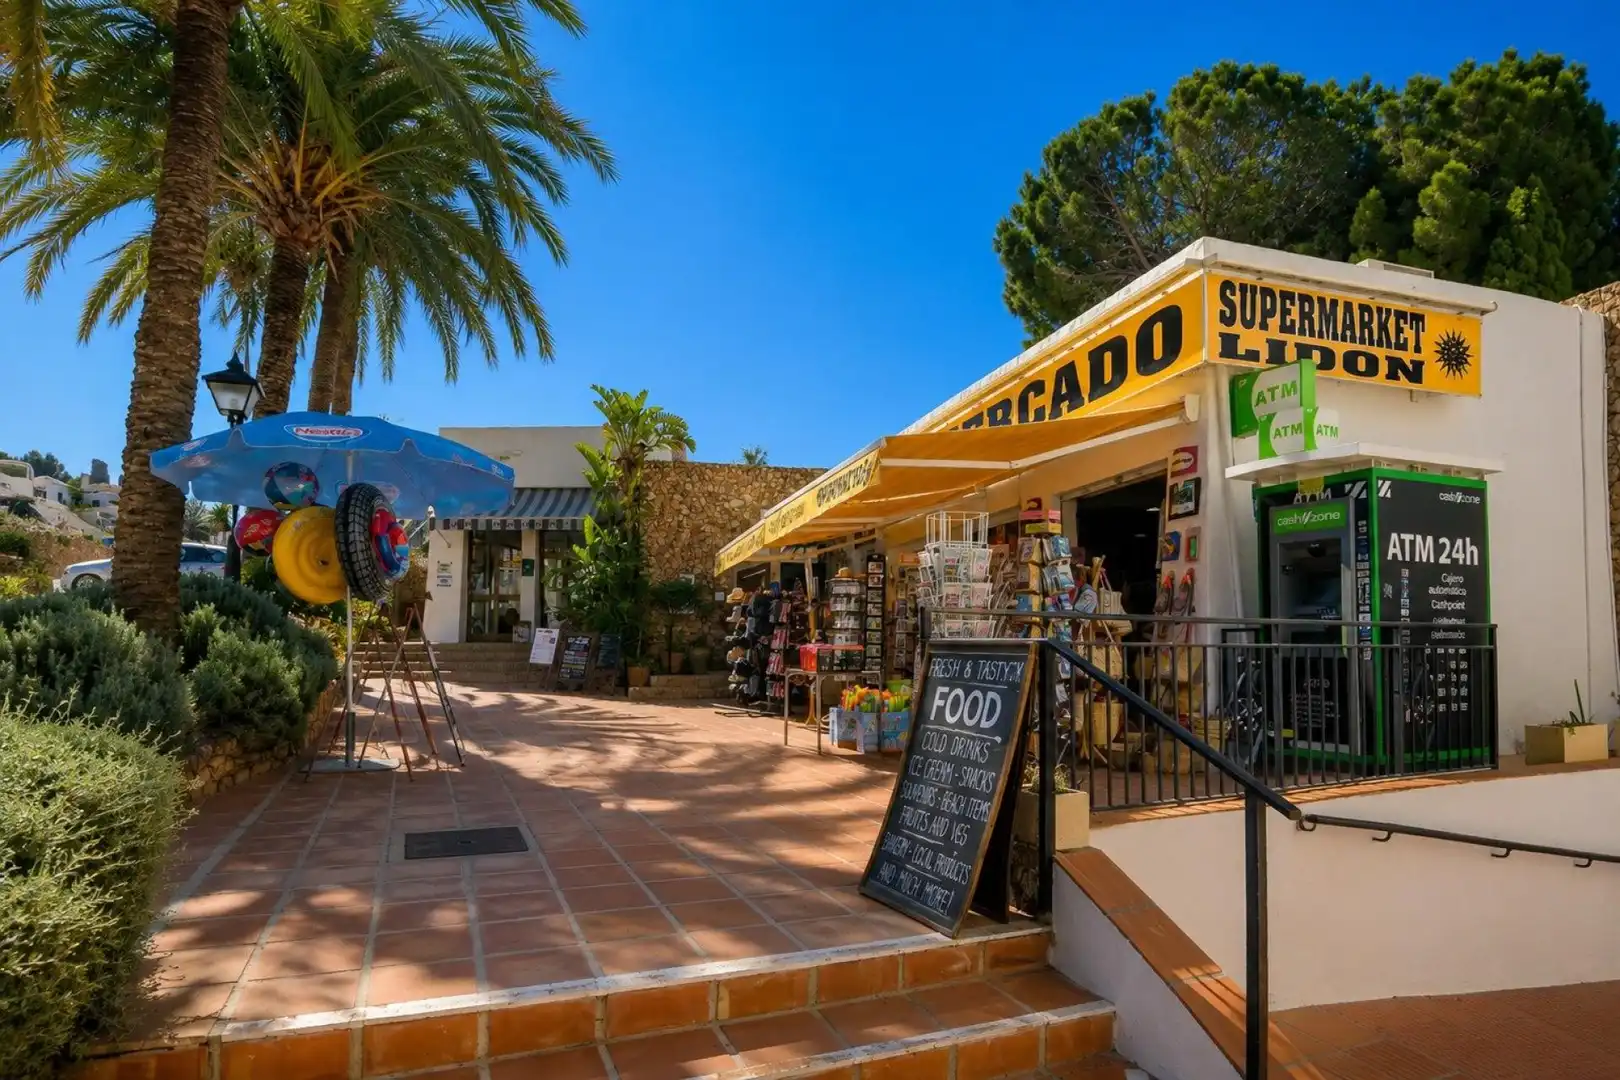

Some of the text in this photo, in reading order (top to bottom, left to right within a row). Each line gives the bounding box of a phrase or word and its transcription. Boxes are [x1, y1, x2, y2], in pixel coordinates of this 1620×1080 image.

[1218, 279, 1426, 354] SUPERMARKET
[1218, 331, 1425, 385] LIDON
[1254, 380, 1298, 407] ATM
[1273, 422, 1303, 440] ATM
[1316, 423, 1339, 439] ATM
[1387, 532, 1479, 566] ATM 24h
[928, 657, 962, 678] FRESH
[963, 660, 974, 679] &
[929, 686, 1002, 729] FOOD
[921, 731, 991, 764] COLD DRINKS
[908, 754, 924, 777] ICE
[958, 766, 997, 793] SNACKS
[898, 805, 931, 831] FRUITS
[927, 815, 950, 838] AND
[940, 791, 968, 815] BEACH
[965, 797, 991, 822] ITEMS
[911, 843, 934, 870] LOCAL
[933, 853, 972, 885] PRODUCTS
